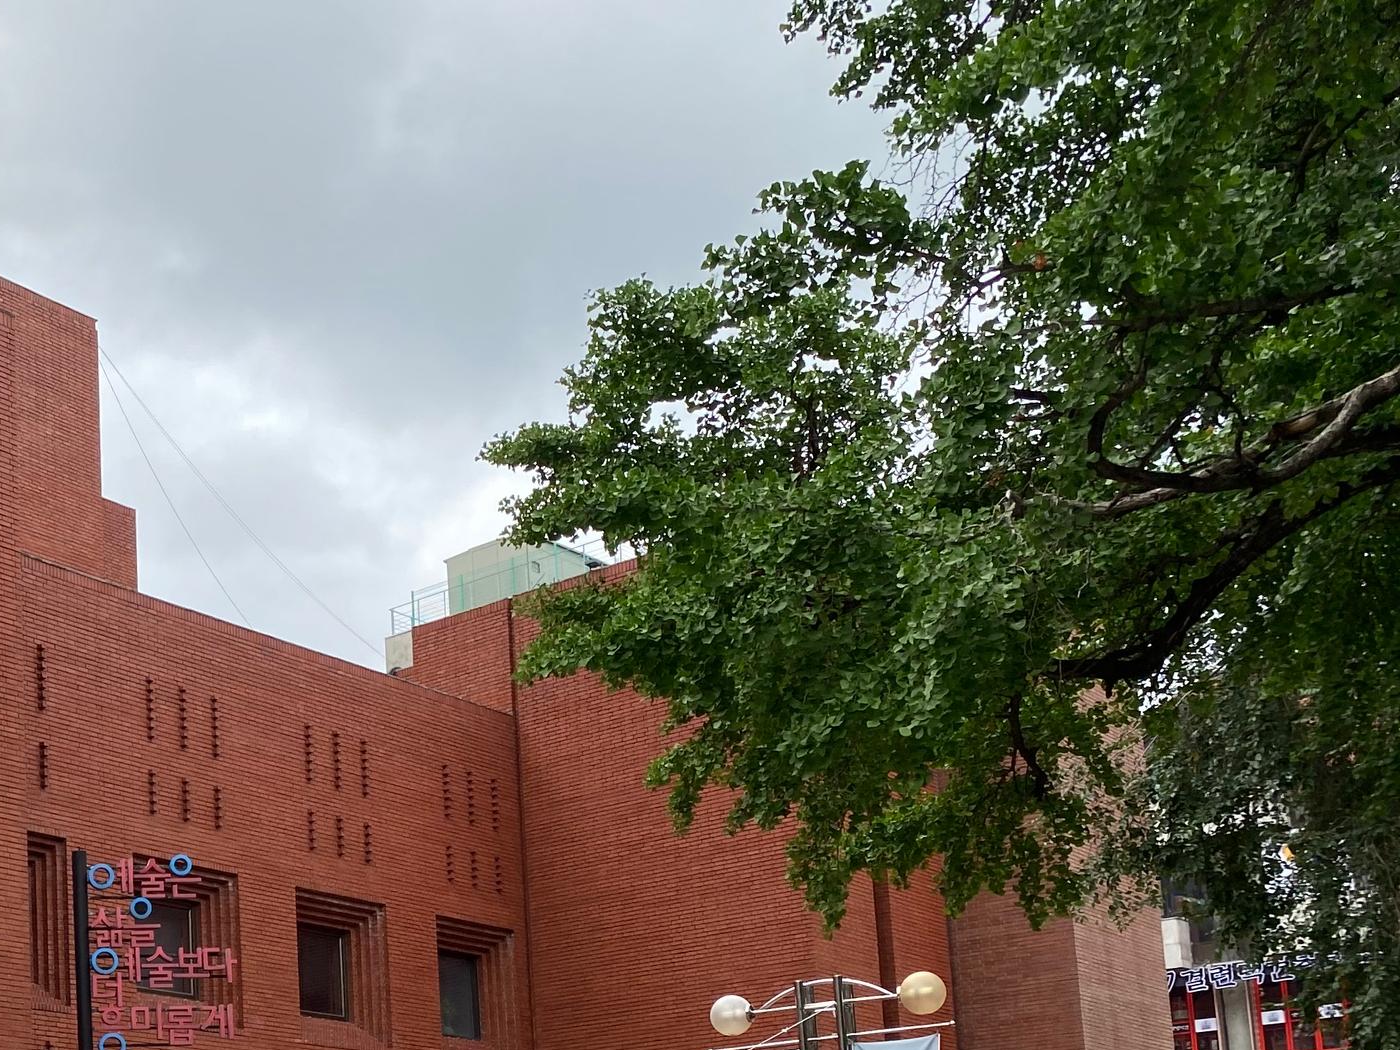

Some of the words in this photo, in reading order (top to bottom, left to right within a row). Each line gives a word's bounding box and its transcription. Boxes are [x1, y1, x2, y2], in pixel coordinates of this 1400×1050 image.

[88, 854, 202, 898] 예술은
[92, 897, 161, 947] 삶을
[90, 946, 237, 988] 예술보다
[92, 972, 123, 1007] 더
